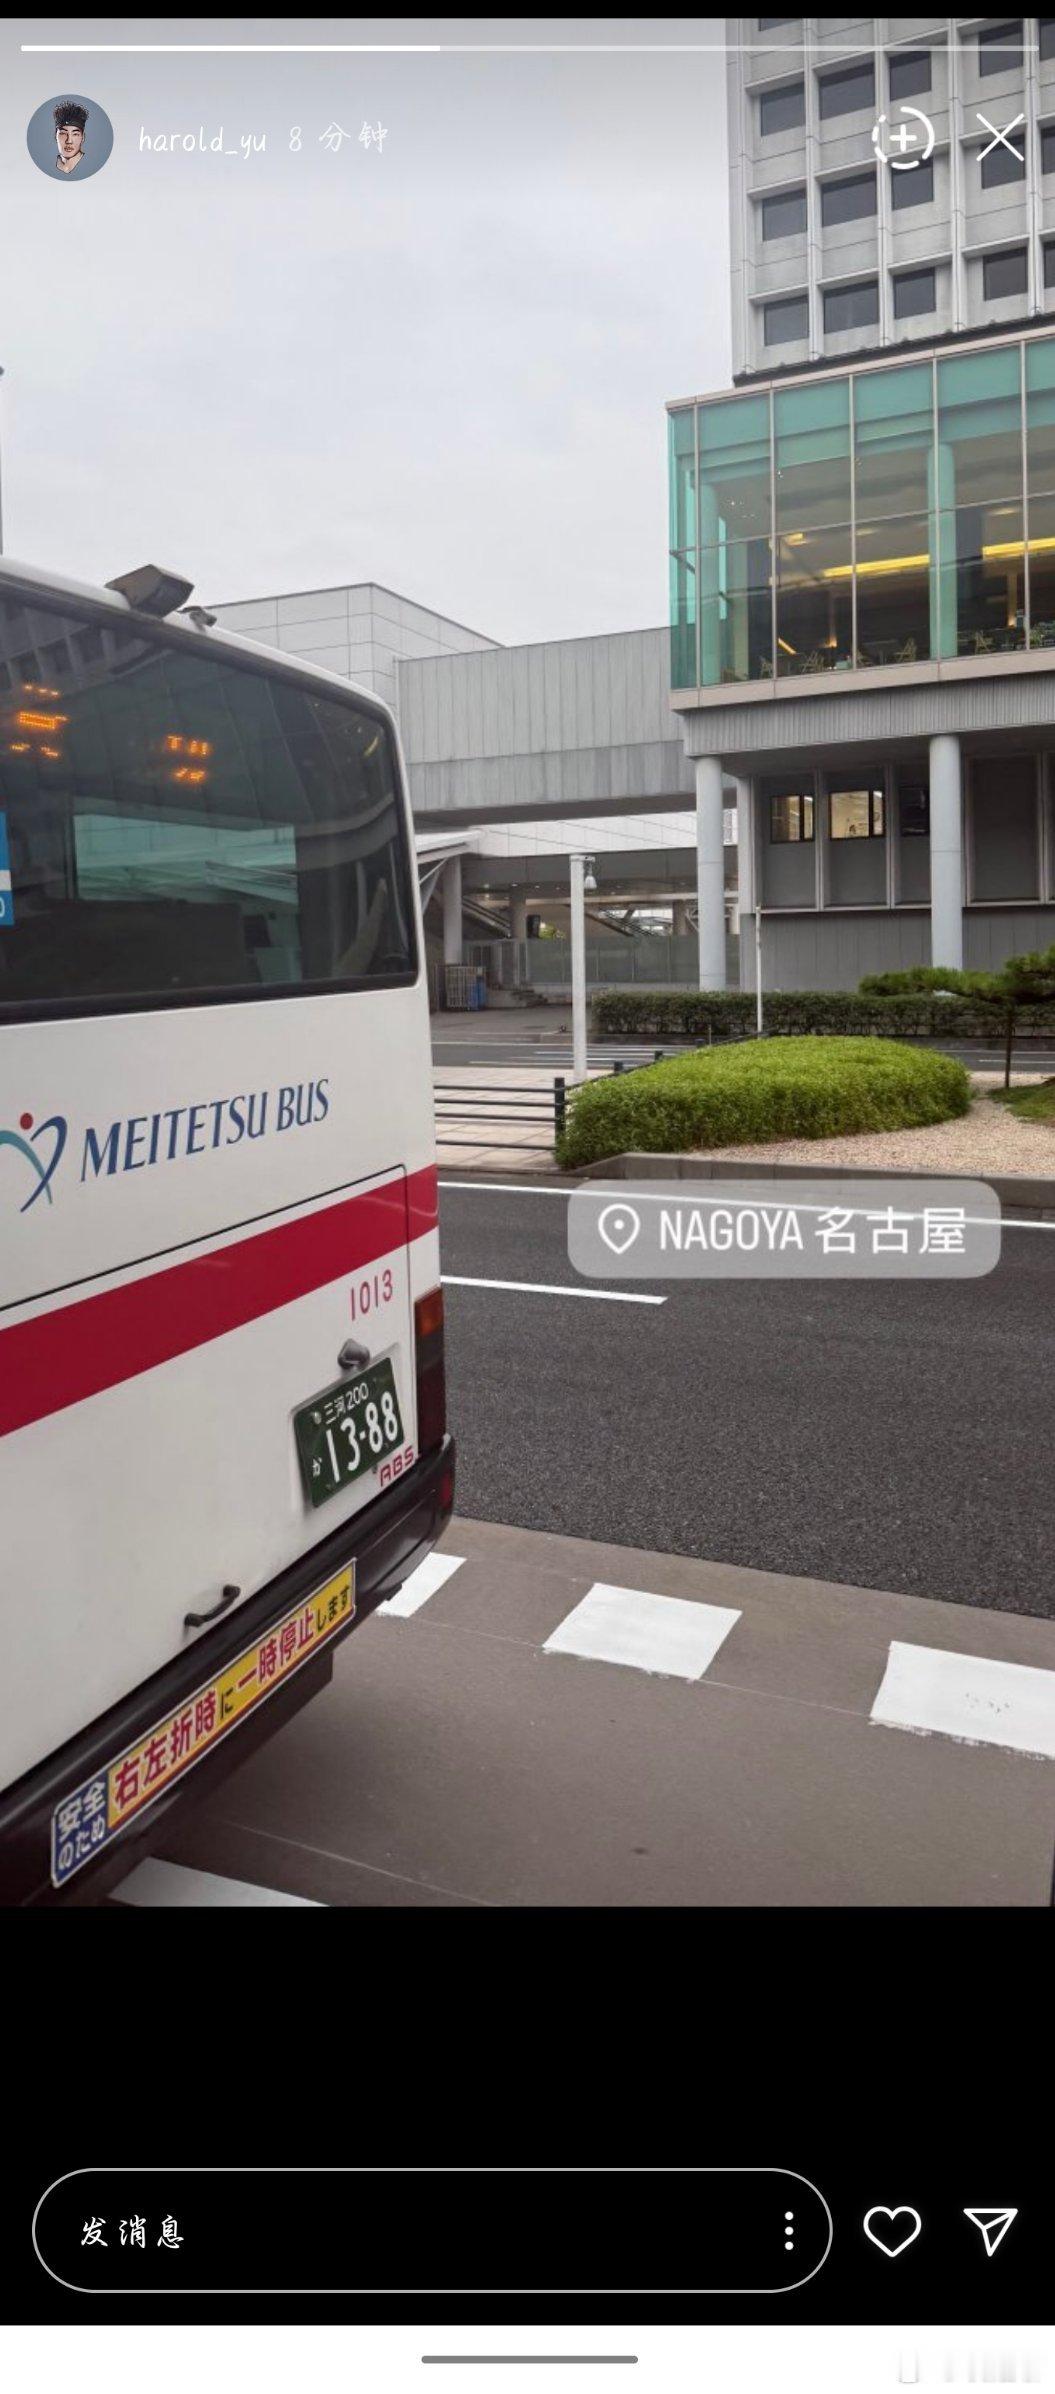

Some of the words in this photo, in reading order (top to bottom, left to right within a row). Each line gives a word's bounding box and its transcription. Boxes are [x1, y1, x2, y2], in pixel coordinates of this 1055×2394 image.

[80, 1091, 268, 1182] MEITETSU
[275, 1078, 329, 1131] BUS
[351, 1269, 393, 1321] 1013
[325, 1391, 398, 1483] 13-88
[380, 1445, 415, 1487] ABS
[58, 1781, 106, 1843] 安全
[58, 1815, 106, 1871] のため
